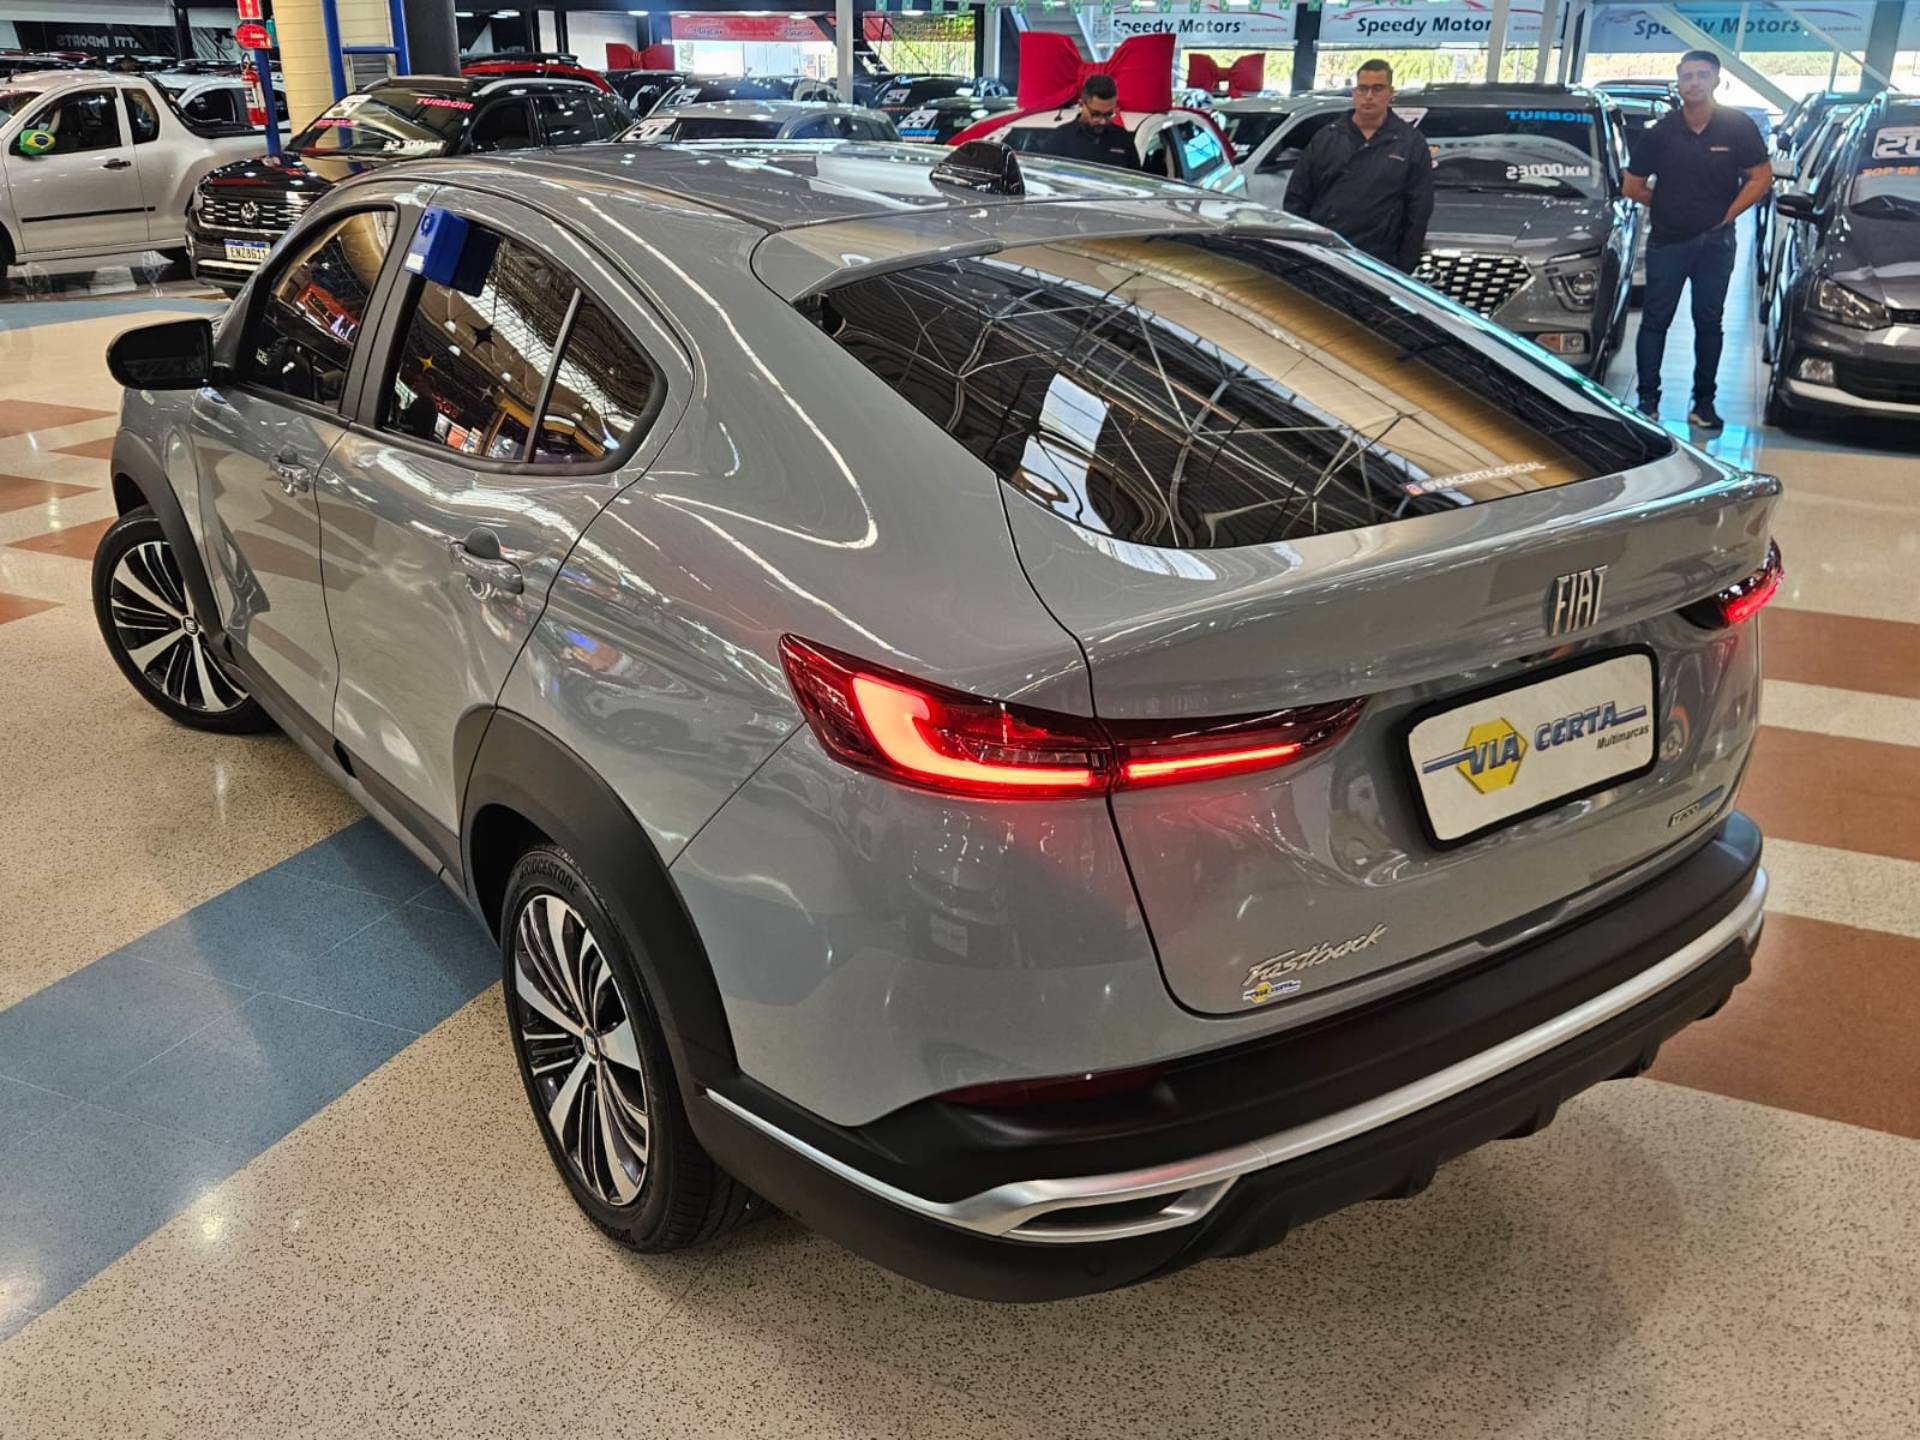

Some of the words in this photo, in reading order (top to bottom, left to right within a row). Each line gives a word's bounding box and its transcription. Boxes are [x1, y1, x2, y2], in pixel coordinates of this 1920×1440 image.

[1178, 18, 1241, 33] Motors
[1356, 17, 1427, 37] Speedy
[1432, 16, 1492, 32] Motor
[1633, 19, 1715, 40] Spey
[1550, 564, 1609, 637] FIAT
[1466, 731, 1521, 776] VIA
[1535, 701, 1617, 752] CERTA
[1597, 724, 1649, 750] Multimarcas
[1242, 922, 1388, 987] Fastback
